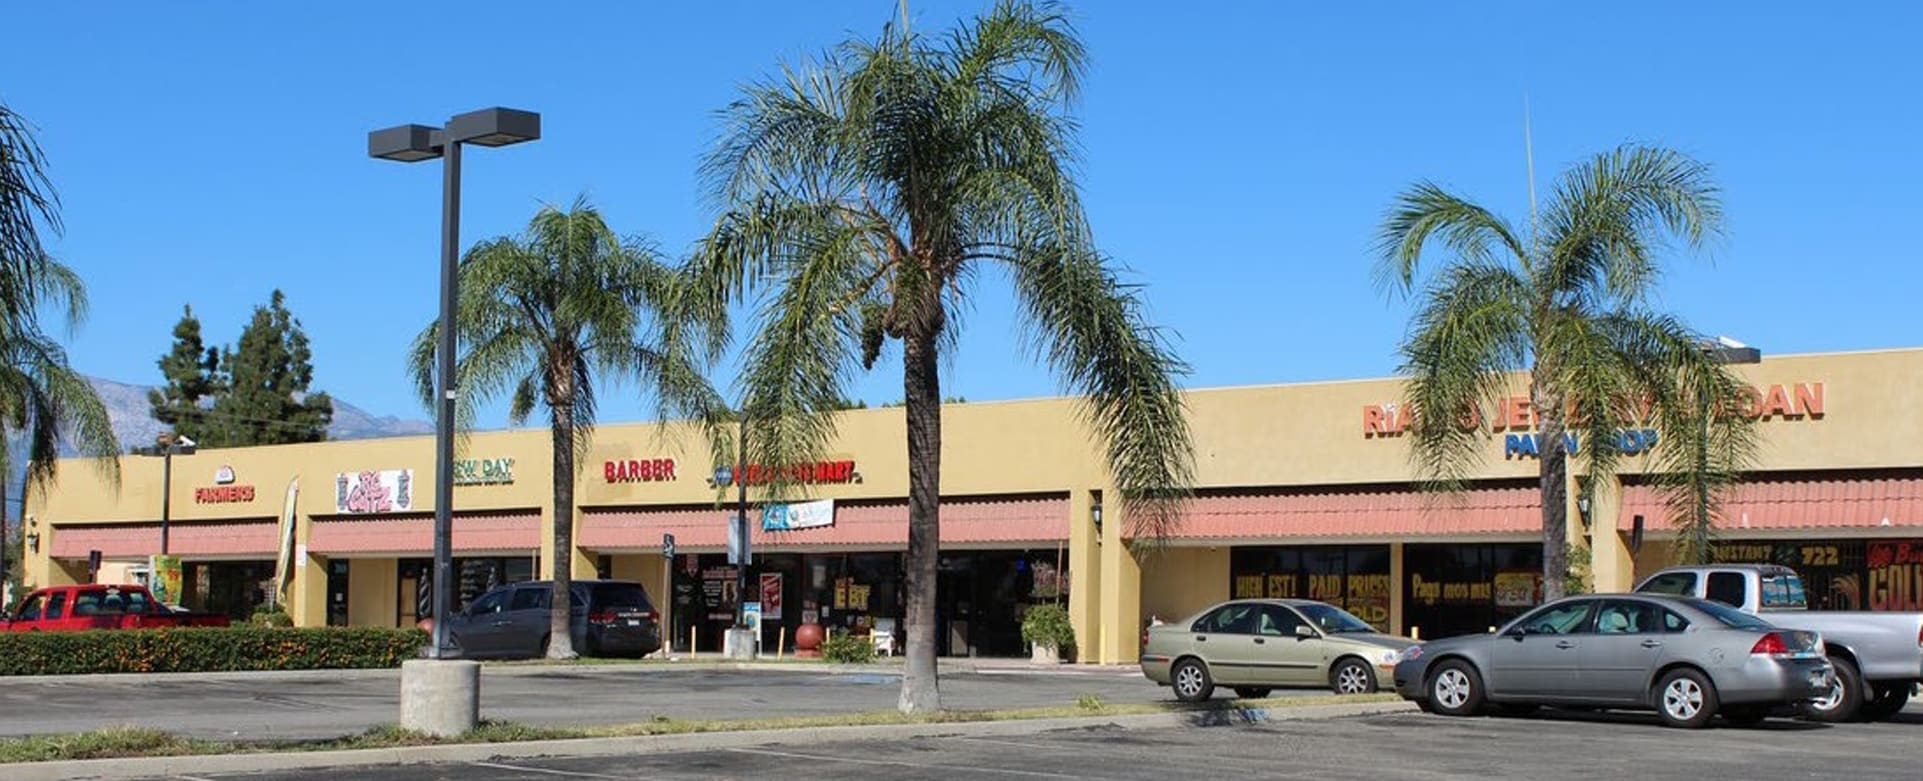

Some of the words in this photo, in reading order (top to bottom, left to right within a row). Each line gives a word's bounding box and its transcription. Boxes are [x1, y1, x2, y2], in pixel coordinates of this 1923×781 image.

[1505, 432, 1580, 458] PAN
[483, 457, 513, 476] DAY
[604, 458, 676, 483] BARBER
[814, 460, 854, 483] MART
[195, 486, 255, 504] FARMERS
[1308, 574, 1341, 597] PAID
[835, 586, 870, 610] EBT
